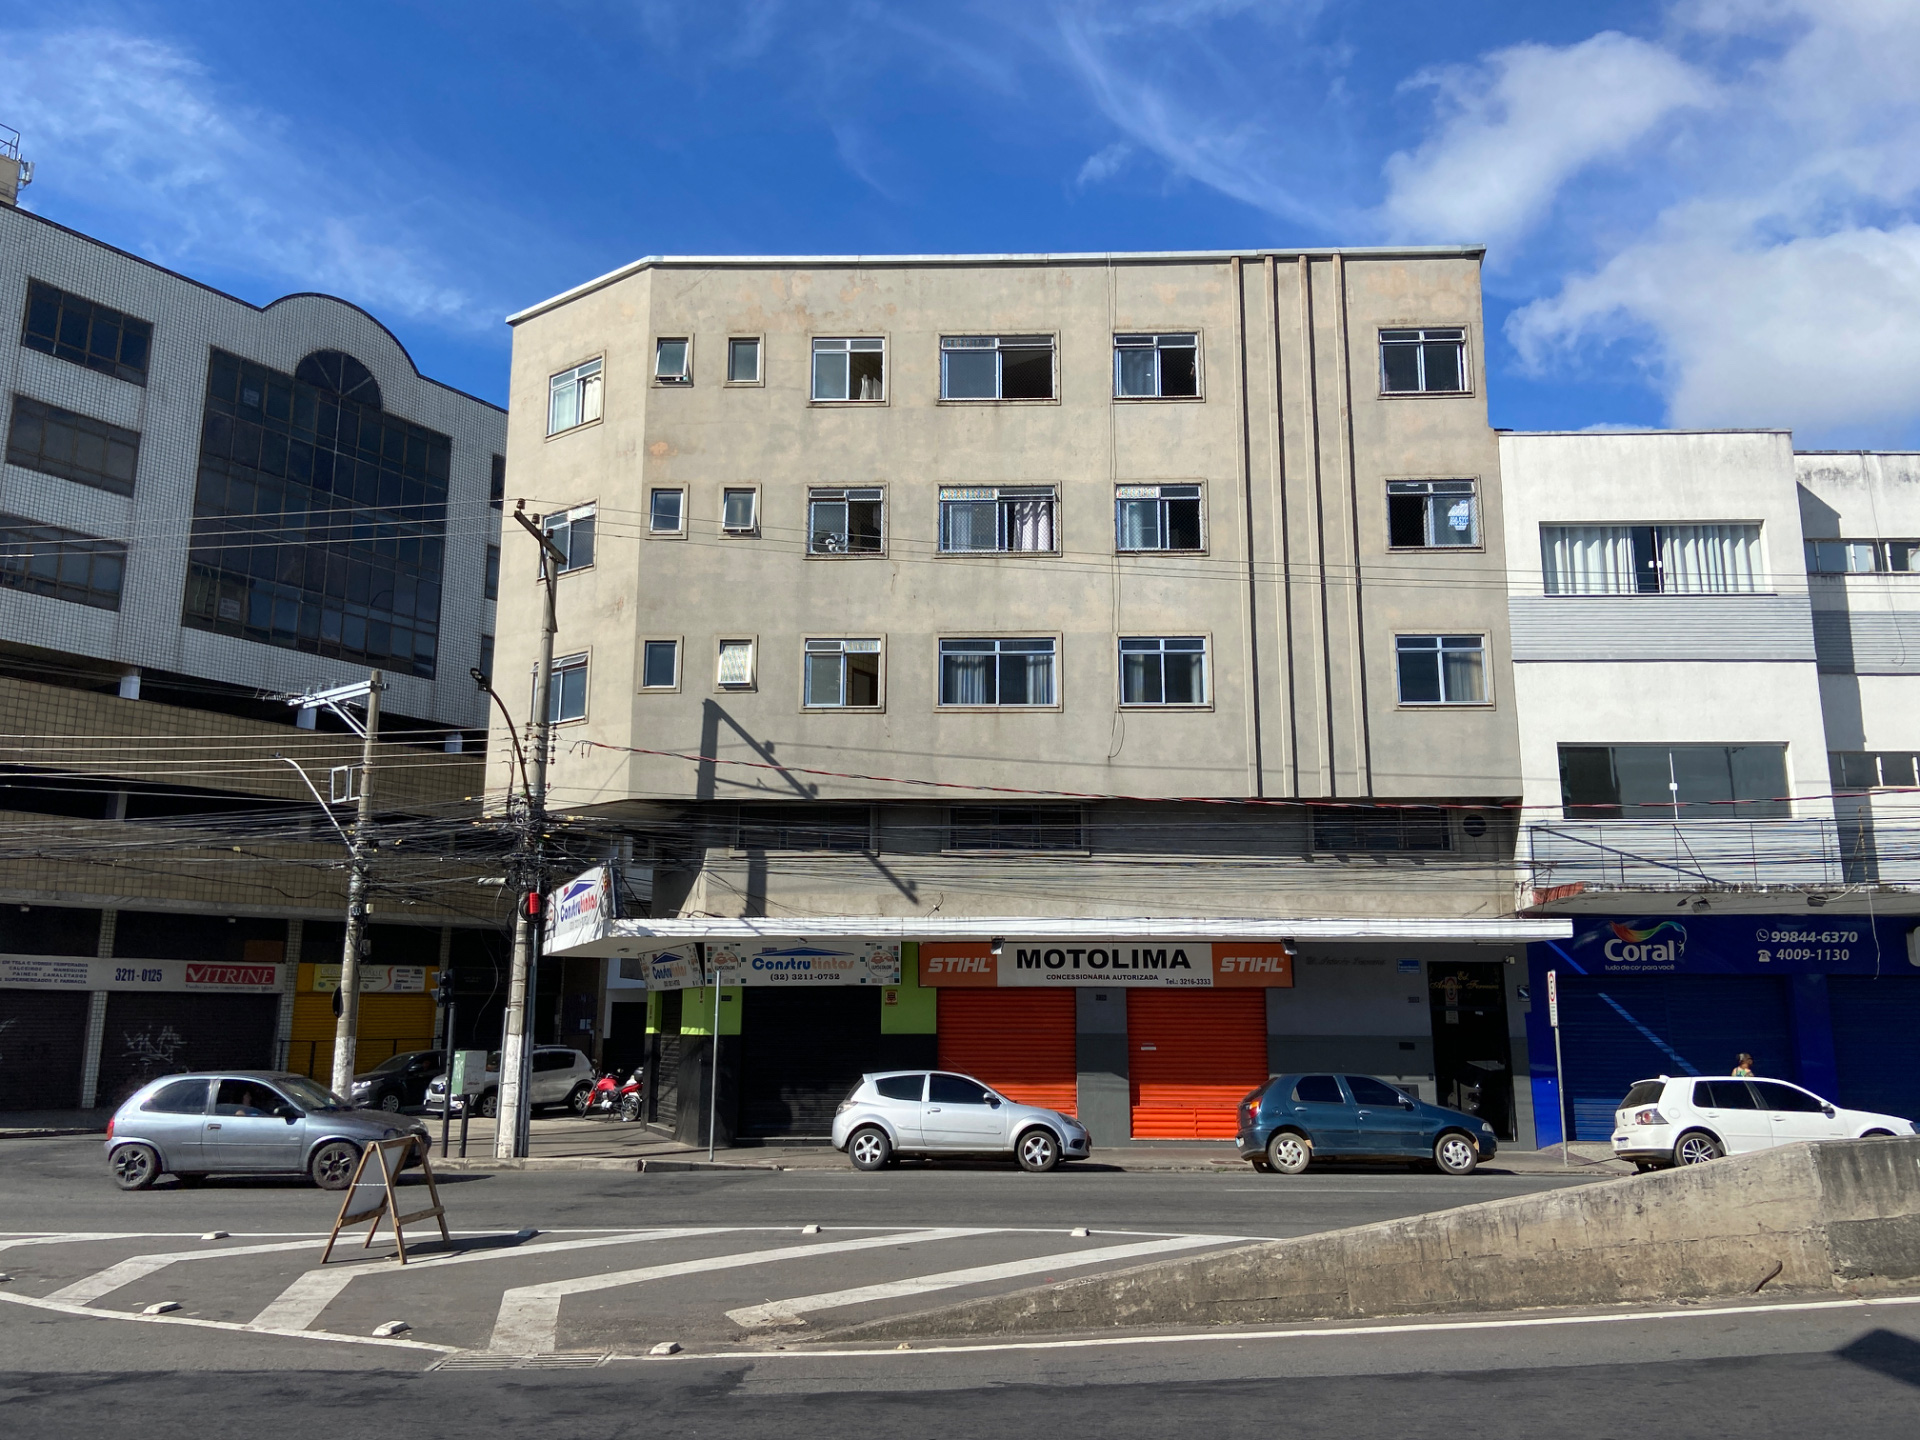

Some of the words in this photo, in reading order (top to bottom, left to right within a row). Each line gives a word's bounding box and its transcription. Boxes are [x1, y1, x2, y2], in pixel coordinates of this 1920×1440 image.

[1771, 931, 1858, 943] 99844-6370
[1604, 939, 1675, 961] Coral
[1776, 949, 1850, 960] 4009-1130
[752, 957, 855, 970] Construtintas
[928, 957, 990, 973] STIHL
[1016, 949, 1192, 969] MOTOLIMA
[1220, 957, 1283, 973] STIHL
[115, 967, 135, 982] 3211
[141, 968, 162, 982] 0125
[187, 963, 274, 985] VITRINE
[770, 973, 789, 982] (32)
[791, 973, 841, 981] 3211-0752
[1179, 978, 1212, 986] 3216-3333
